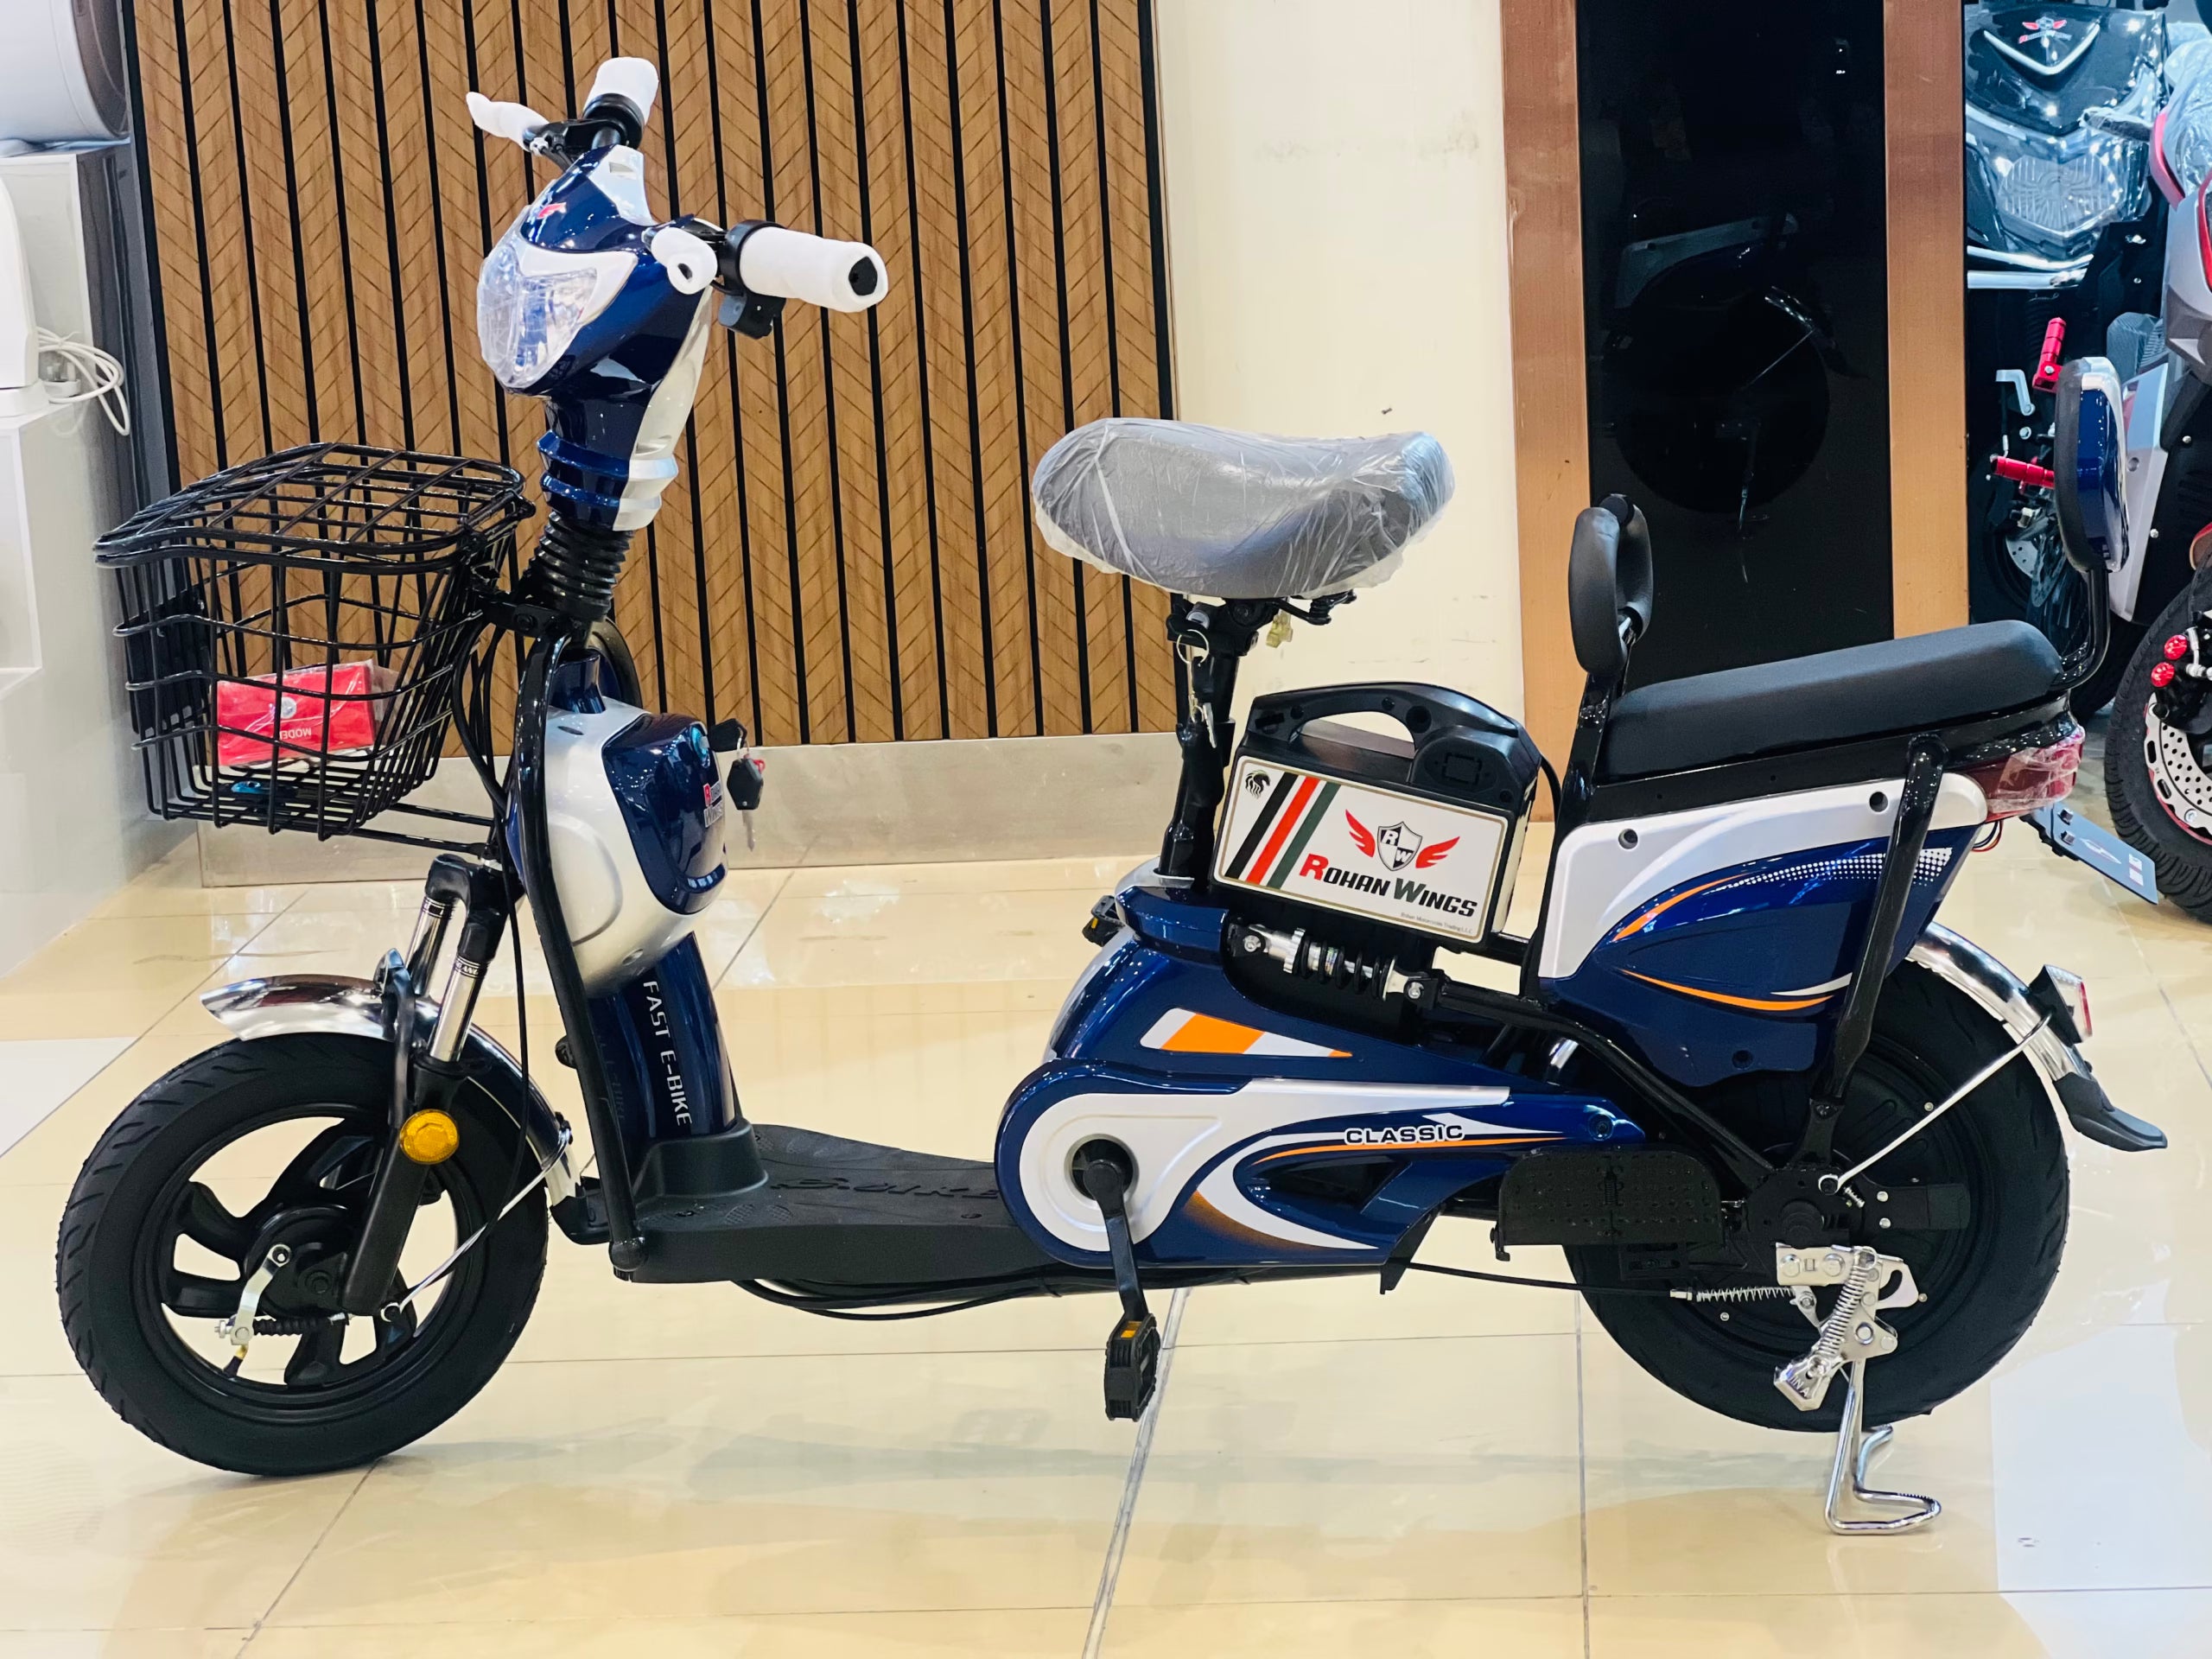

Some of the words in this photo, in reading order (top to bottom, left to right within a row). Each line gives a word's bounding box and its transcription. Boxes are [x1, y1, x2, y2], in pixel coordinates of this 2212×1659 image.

[1299, 853, 1391, 897] ROHAN
[1393, 877, 1478, 918] WINGS
[643, 981, 671, 1038] FAST
[659, 1050, 693, 1127] E-BIKE
[1345, 1125, 1464, 1144] CLASSIC
